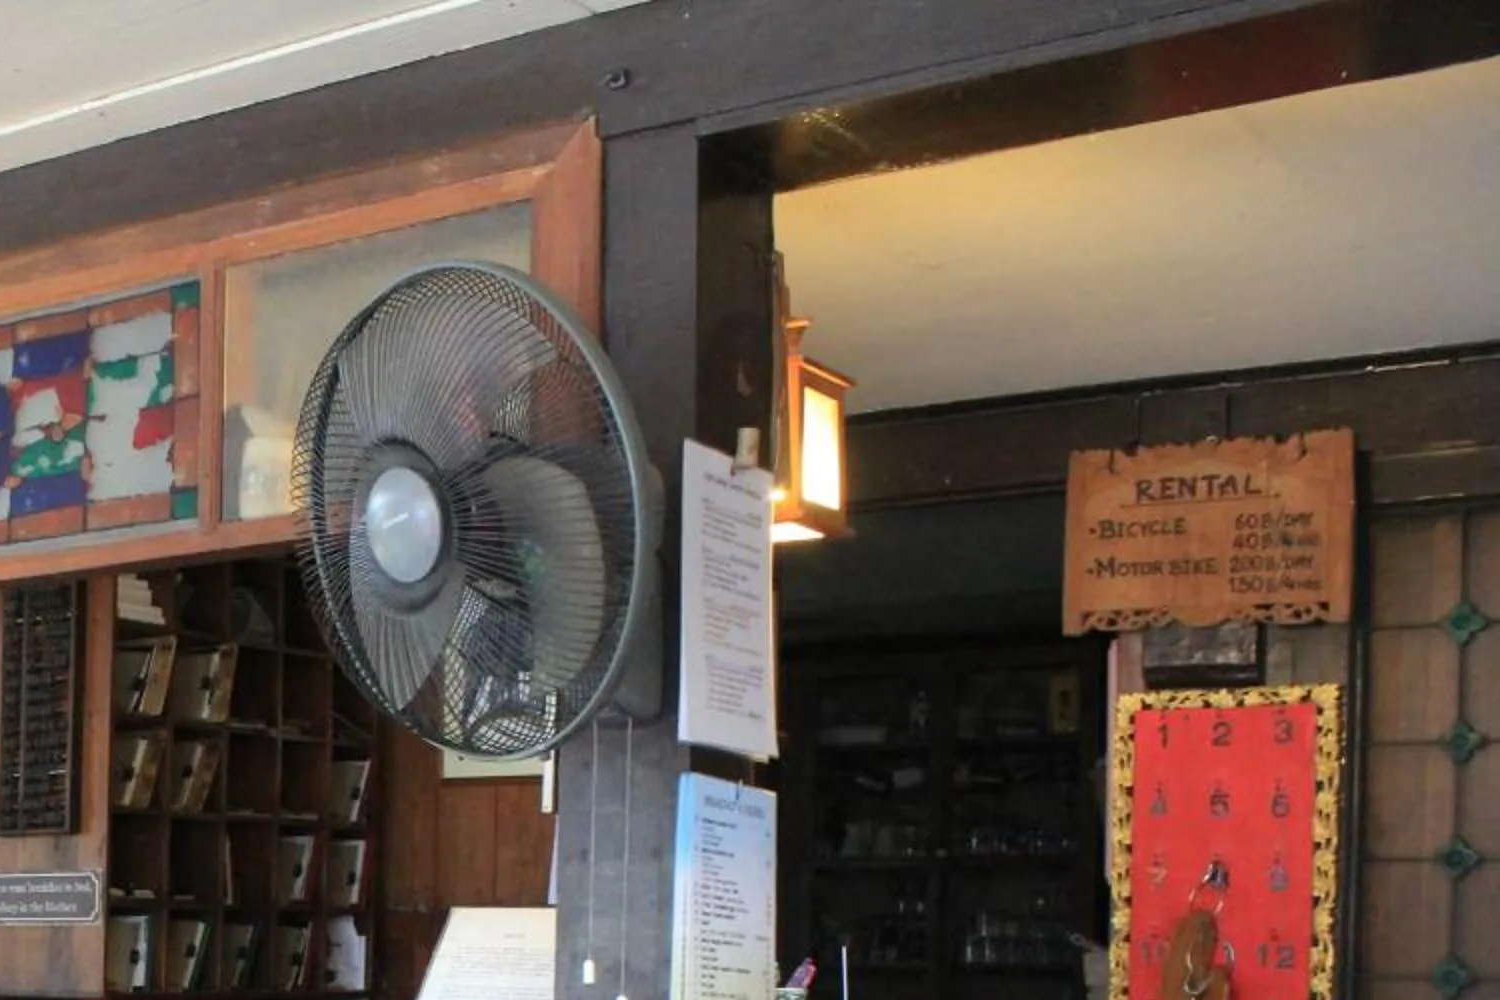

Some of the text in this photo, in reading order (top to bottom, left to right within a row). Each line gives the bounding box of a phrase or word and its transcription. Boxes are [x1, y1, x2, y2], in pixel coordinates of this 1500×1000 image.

[1136, 474, 1262, 502] RENTAL
[1098, 517, 1187, 539] BICYCLE
[1156, 719, 1295, 749] 1 2 3
[1208, 792, 1231, 817] 5
[1270, 792, 1292, 818] 6
[1257, 943, 1296, 970] 12
